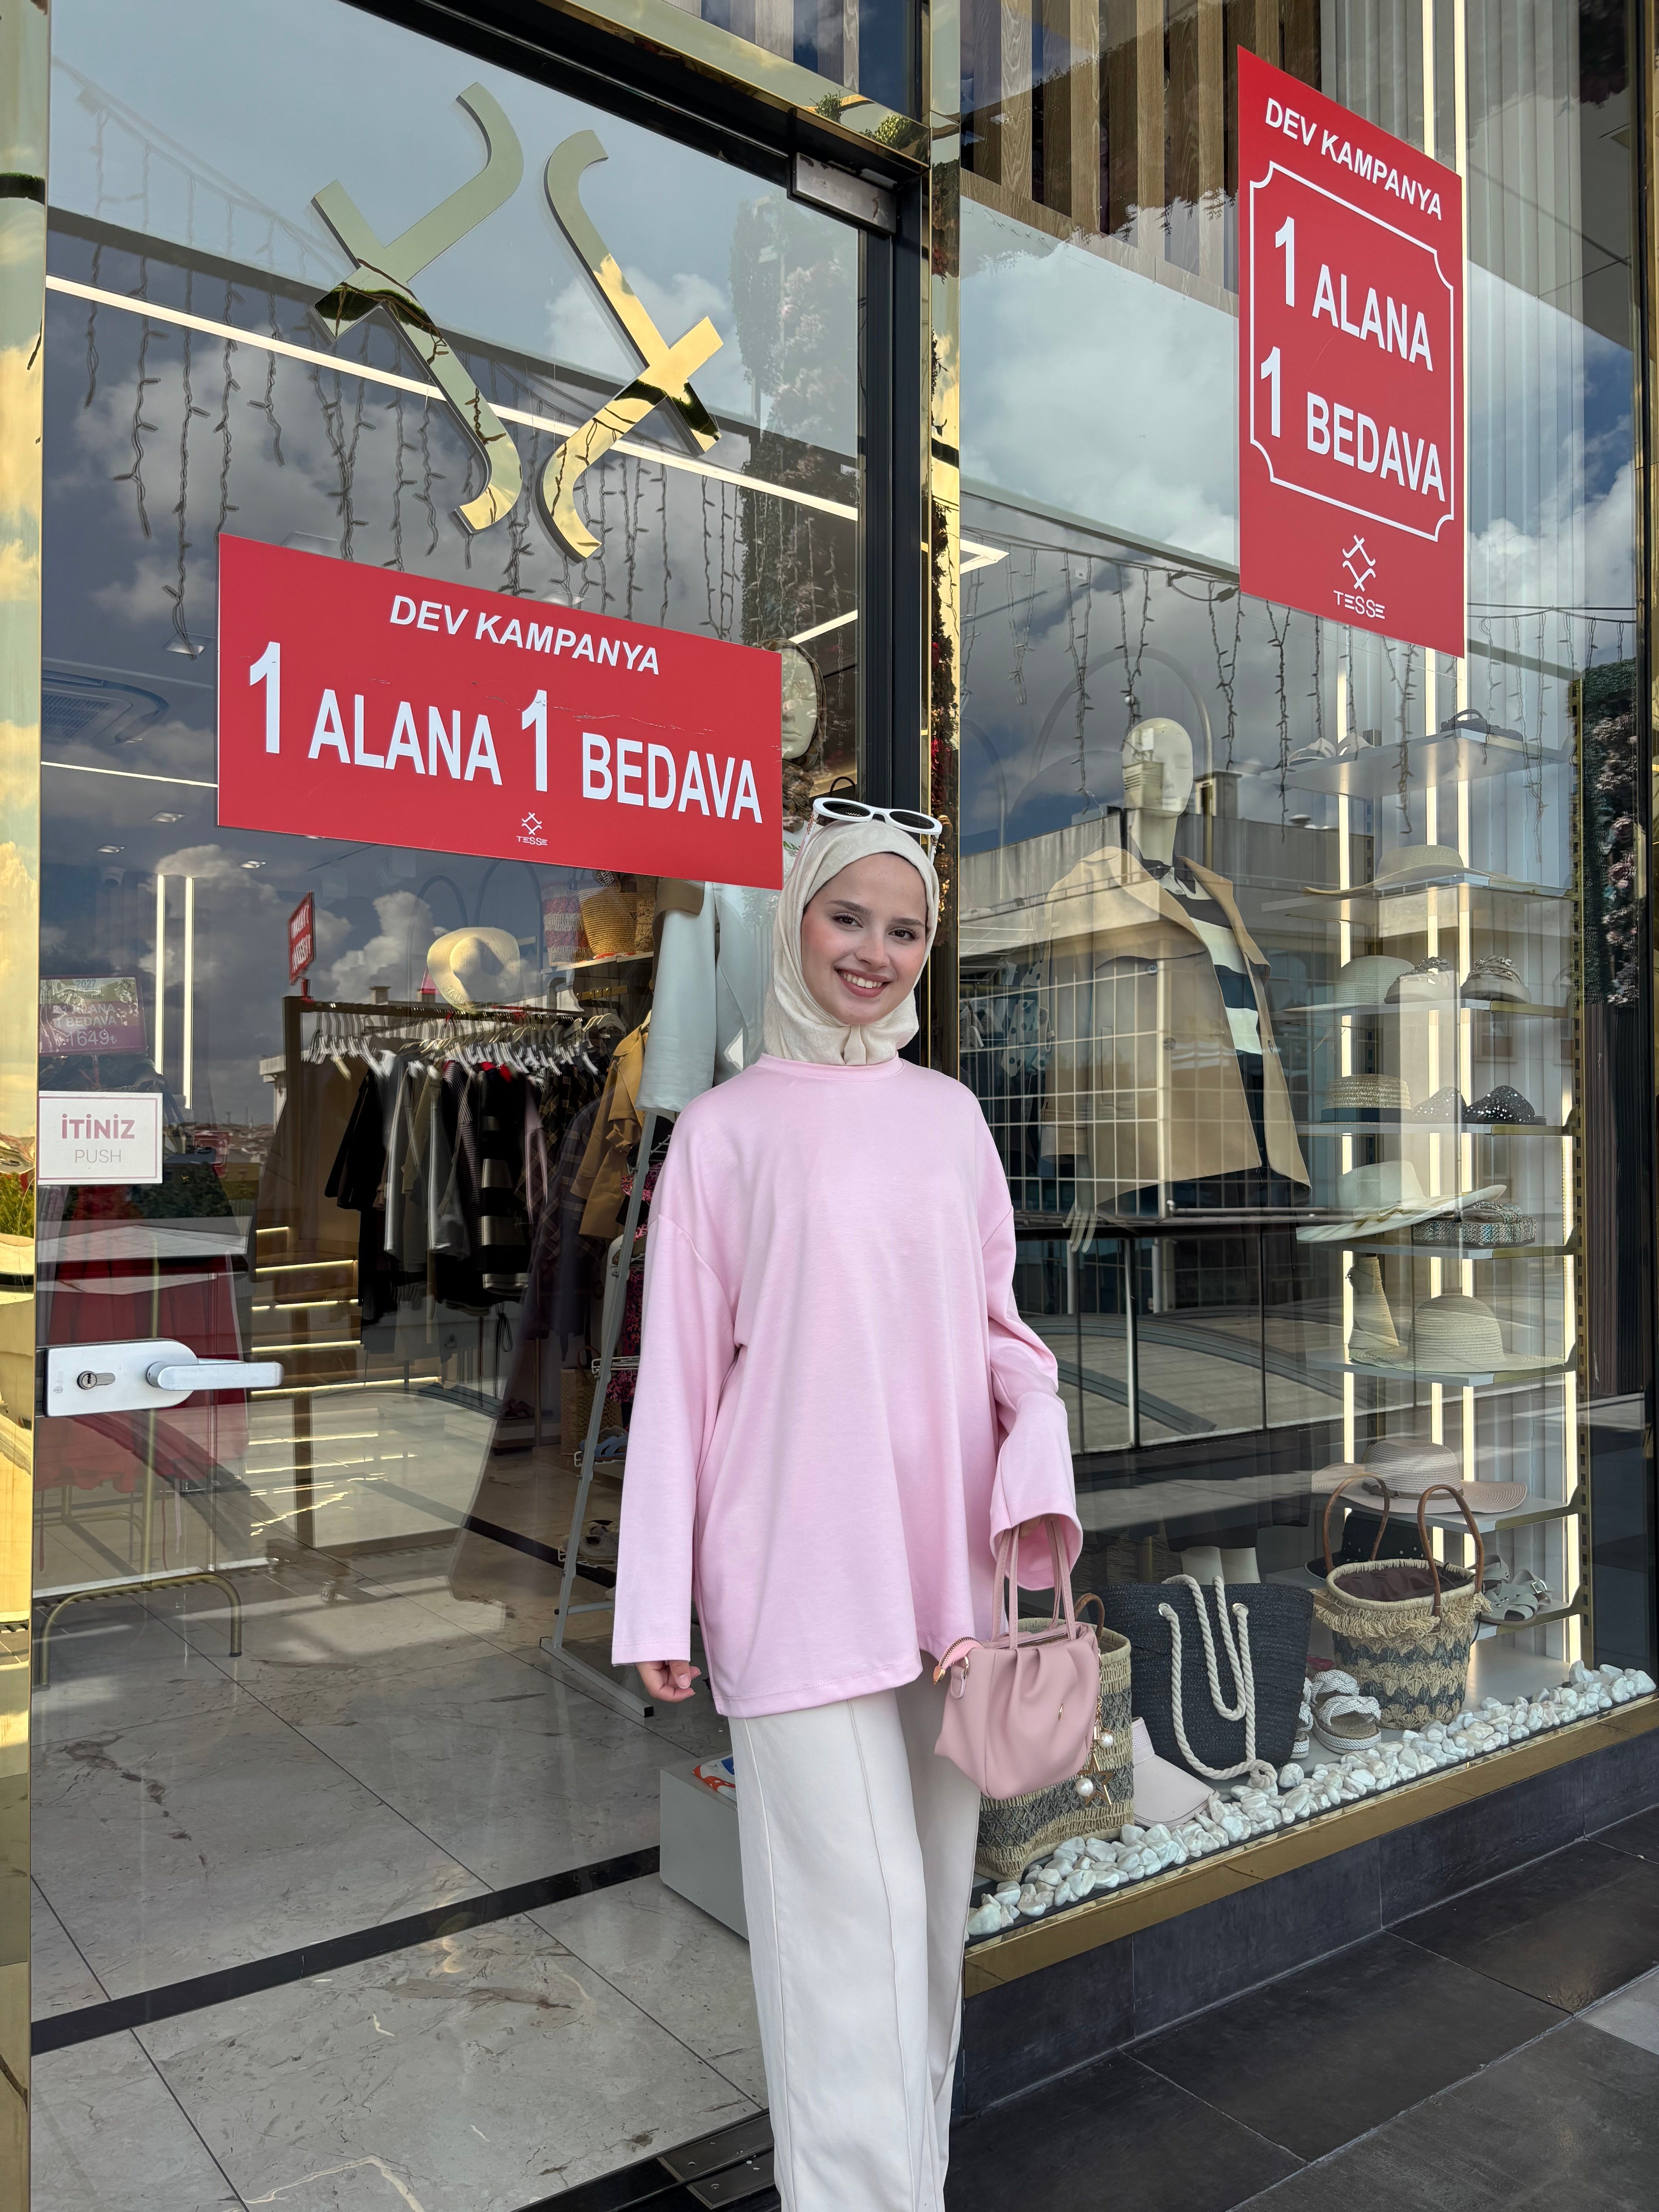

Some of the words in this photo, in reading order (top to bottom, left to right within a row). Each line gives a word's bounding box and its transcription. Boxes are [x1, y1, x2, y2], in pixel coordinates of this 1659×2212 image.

[1265, 98, 1317, 146] DEV
[1321, 129, 1442, 221] KAMPANYA
[1275, 216, 1295, 307] 1
[1312, 264, 1434, 372] ALANA
[1261, 346, 1280, 438] 1
[1307, 391, 1446, 503] BEDAVA
[390, 595, 469, 635] DEV
[475, 612, 659, 675] KAMPANYA
[1333, 590, 1385, 619] TESSE
[250, 641, 280, 754] 1
[308, 689, 503, 785] ALANA
[522, 689, 548, 792] 1
[582, 732, 762, 824] BEDAVA
[516, 835, 548, 846] TESSE
[66, 1015, 117, 1027] BEDAVA
[75, 1149, 121, 1163] PUSH
